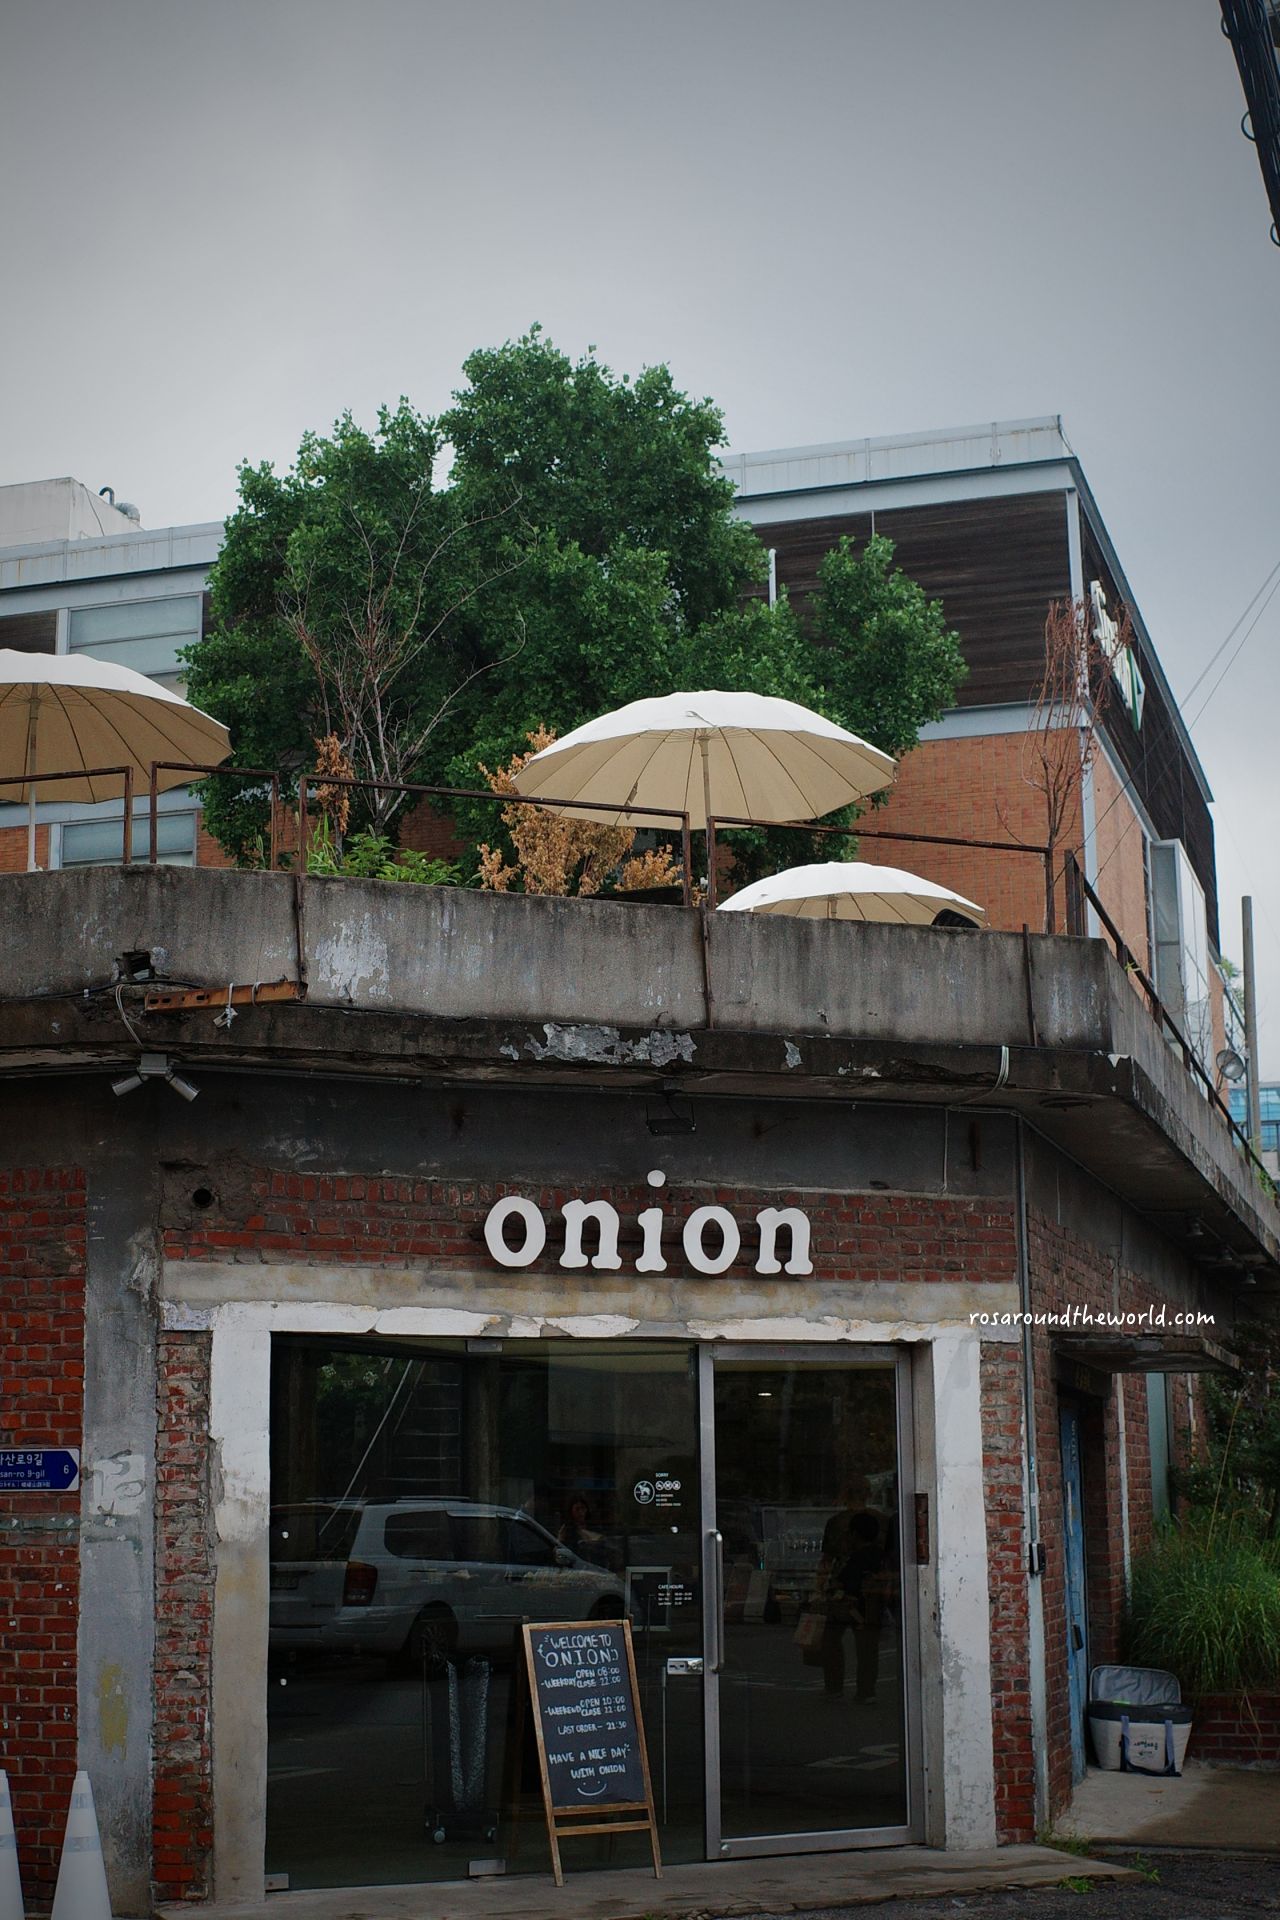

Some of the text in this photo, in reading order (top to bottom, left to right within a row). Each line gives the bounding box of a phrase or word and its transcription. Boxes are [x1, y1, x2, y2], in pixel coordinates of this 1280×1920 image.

[484, 1169, 814, 1275] onion
[550, 1633, 612, 1649] WELCOME TO
[575, 1669, 595, 1679] OPEN
[576, 1679, 597, 1688] CLOSE
[580, 1696, 625, 1708] OPEN 10:00
[581, 1705, 627, 1717] CLOSE 22:00
[557, 1723, 575, 1735] LAST
[575, 1723, 597, 1733] ORDER
[606, 1721, 627, 1731] 21:30
[548, 1747, 626, 1765] HAVE A NICE DAY
[570, 1764, 626, 1779] WITH ONION
